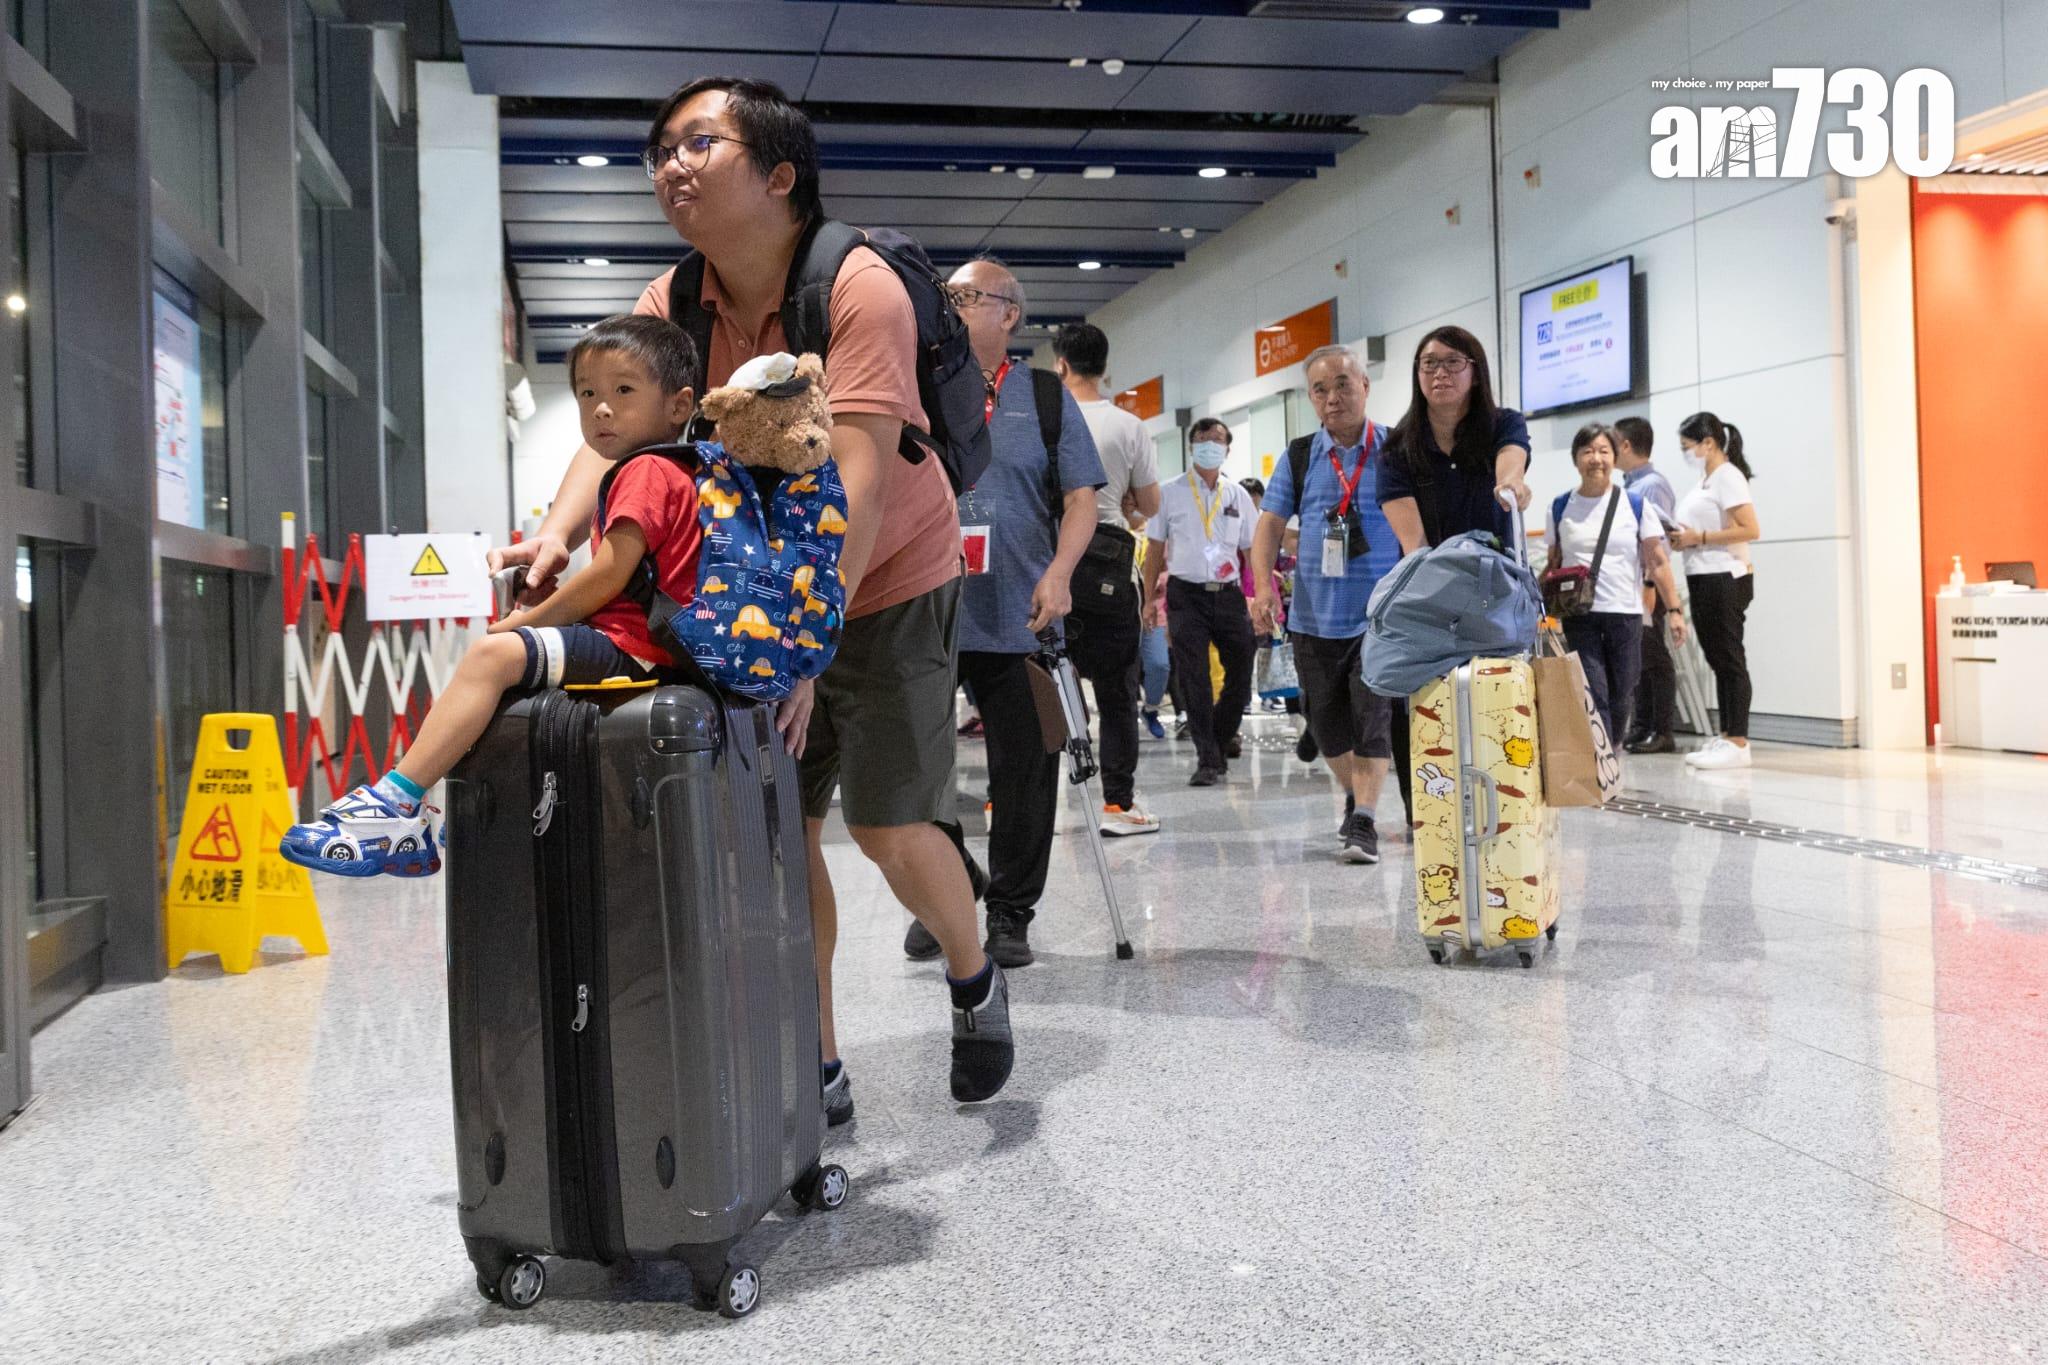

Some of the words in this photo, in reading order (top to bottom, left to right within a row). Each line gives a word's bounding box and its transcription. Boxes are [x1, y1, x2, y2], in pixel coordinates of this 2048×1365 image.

[714, 600, 737, 611] CAR
[204, 768, 249, 780] CAUTION
[197, 783, 219, 794] WET
[221, 783, 253, 795] FLOOR
